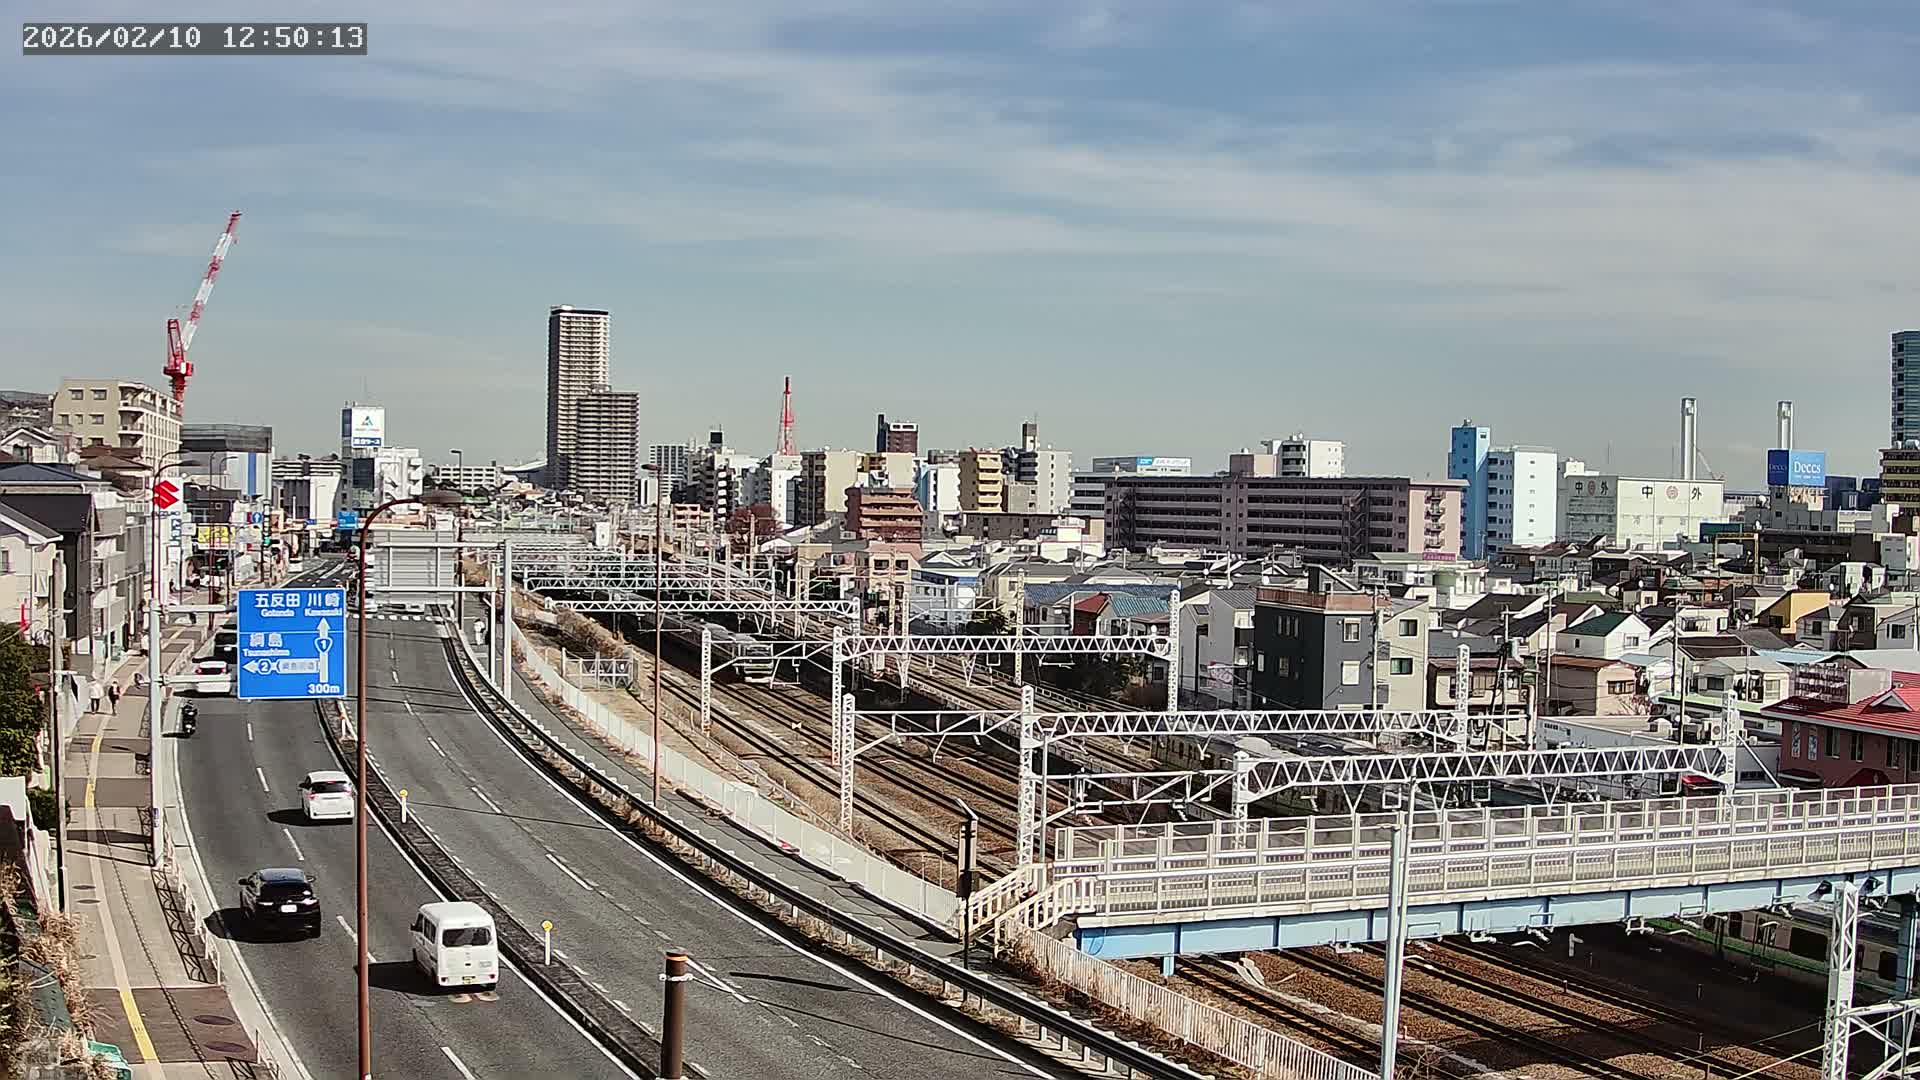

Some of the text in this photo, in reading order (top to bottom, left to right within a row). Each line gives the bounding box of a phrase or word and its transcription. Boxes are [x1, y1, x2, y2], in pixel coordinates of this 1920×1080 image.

[1641, 485, 1702, 500] 中 外
[254, 592, 340, 608] 五反田 川崎
[320, 640, 327, 650] 1
[260, 661, 268, 671] 2
[308, 684, 340, 694] 300m
